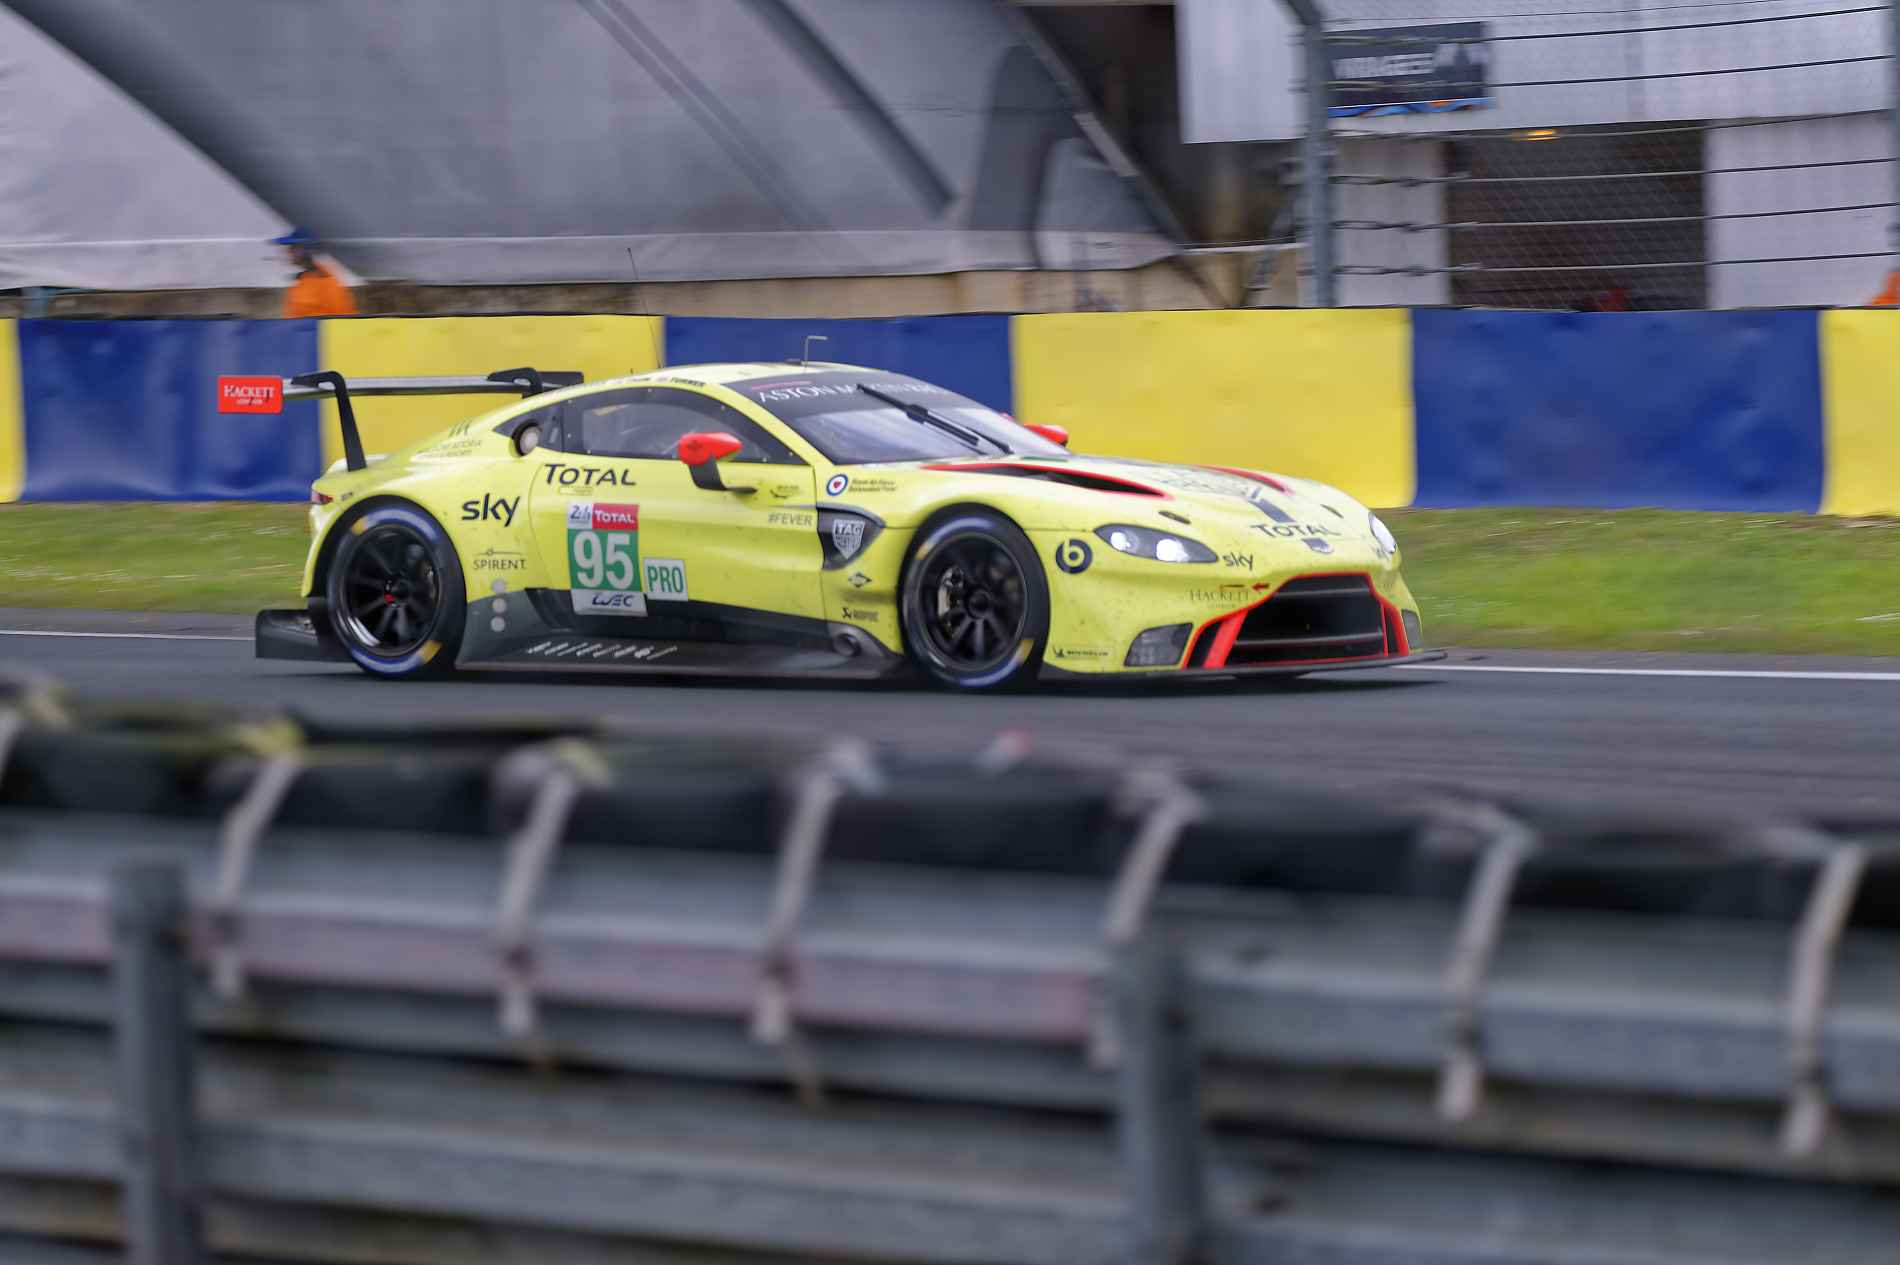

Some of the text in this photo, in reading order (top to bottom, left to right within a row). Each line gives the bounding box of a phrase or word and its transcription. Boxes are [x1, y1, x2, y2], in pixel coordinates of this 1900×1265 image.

[223, 384, 276, 398] HACKETT
[758, 384, 830, 403] ASTON
[545, 463, 636, 486] TOTAL
[461, 492, 520, 528] sky
[594, 509, 635, 525] TOTAL
[768, 511, 813, 527] #FEVER
[1249, 522, 1342, 538] TOTAL
[472, 558, 527, 571] SPIRENT
[573, 531, 634, 590] 95
[1222, 552, 1255, 570] sky
[646, 565, 684, 594] PRO
